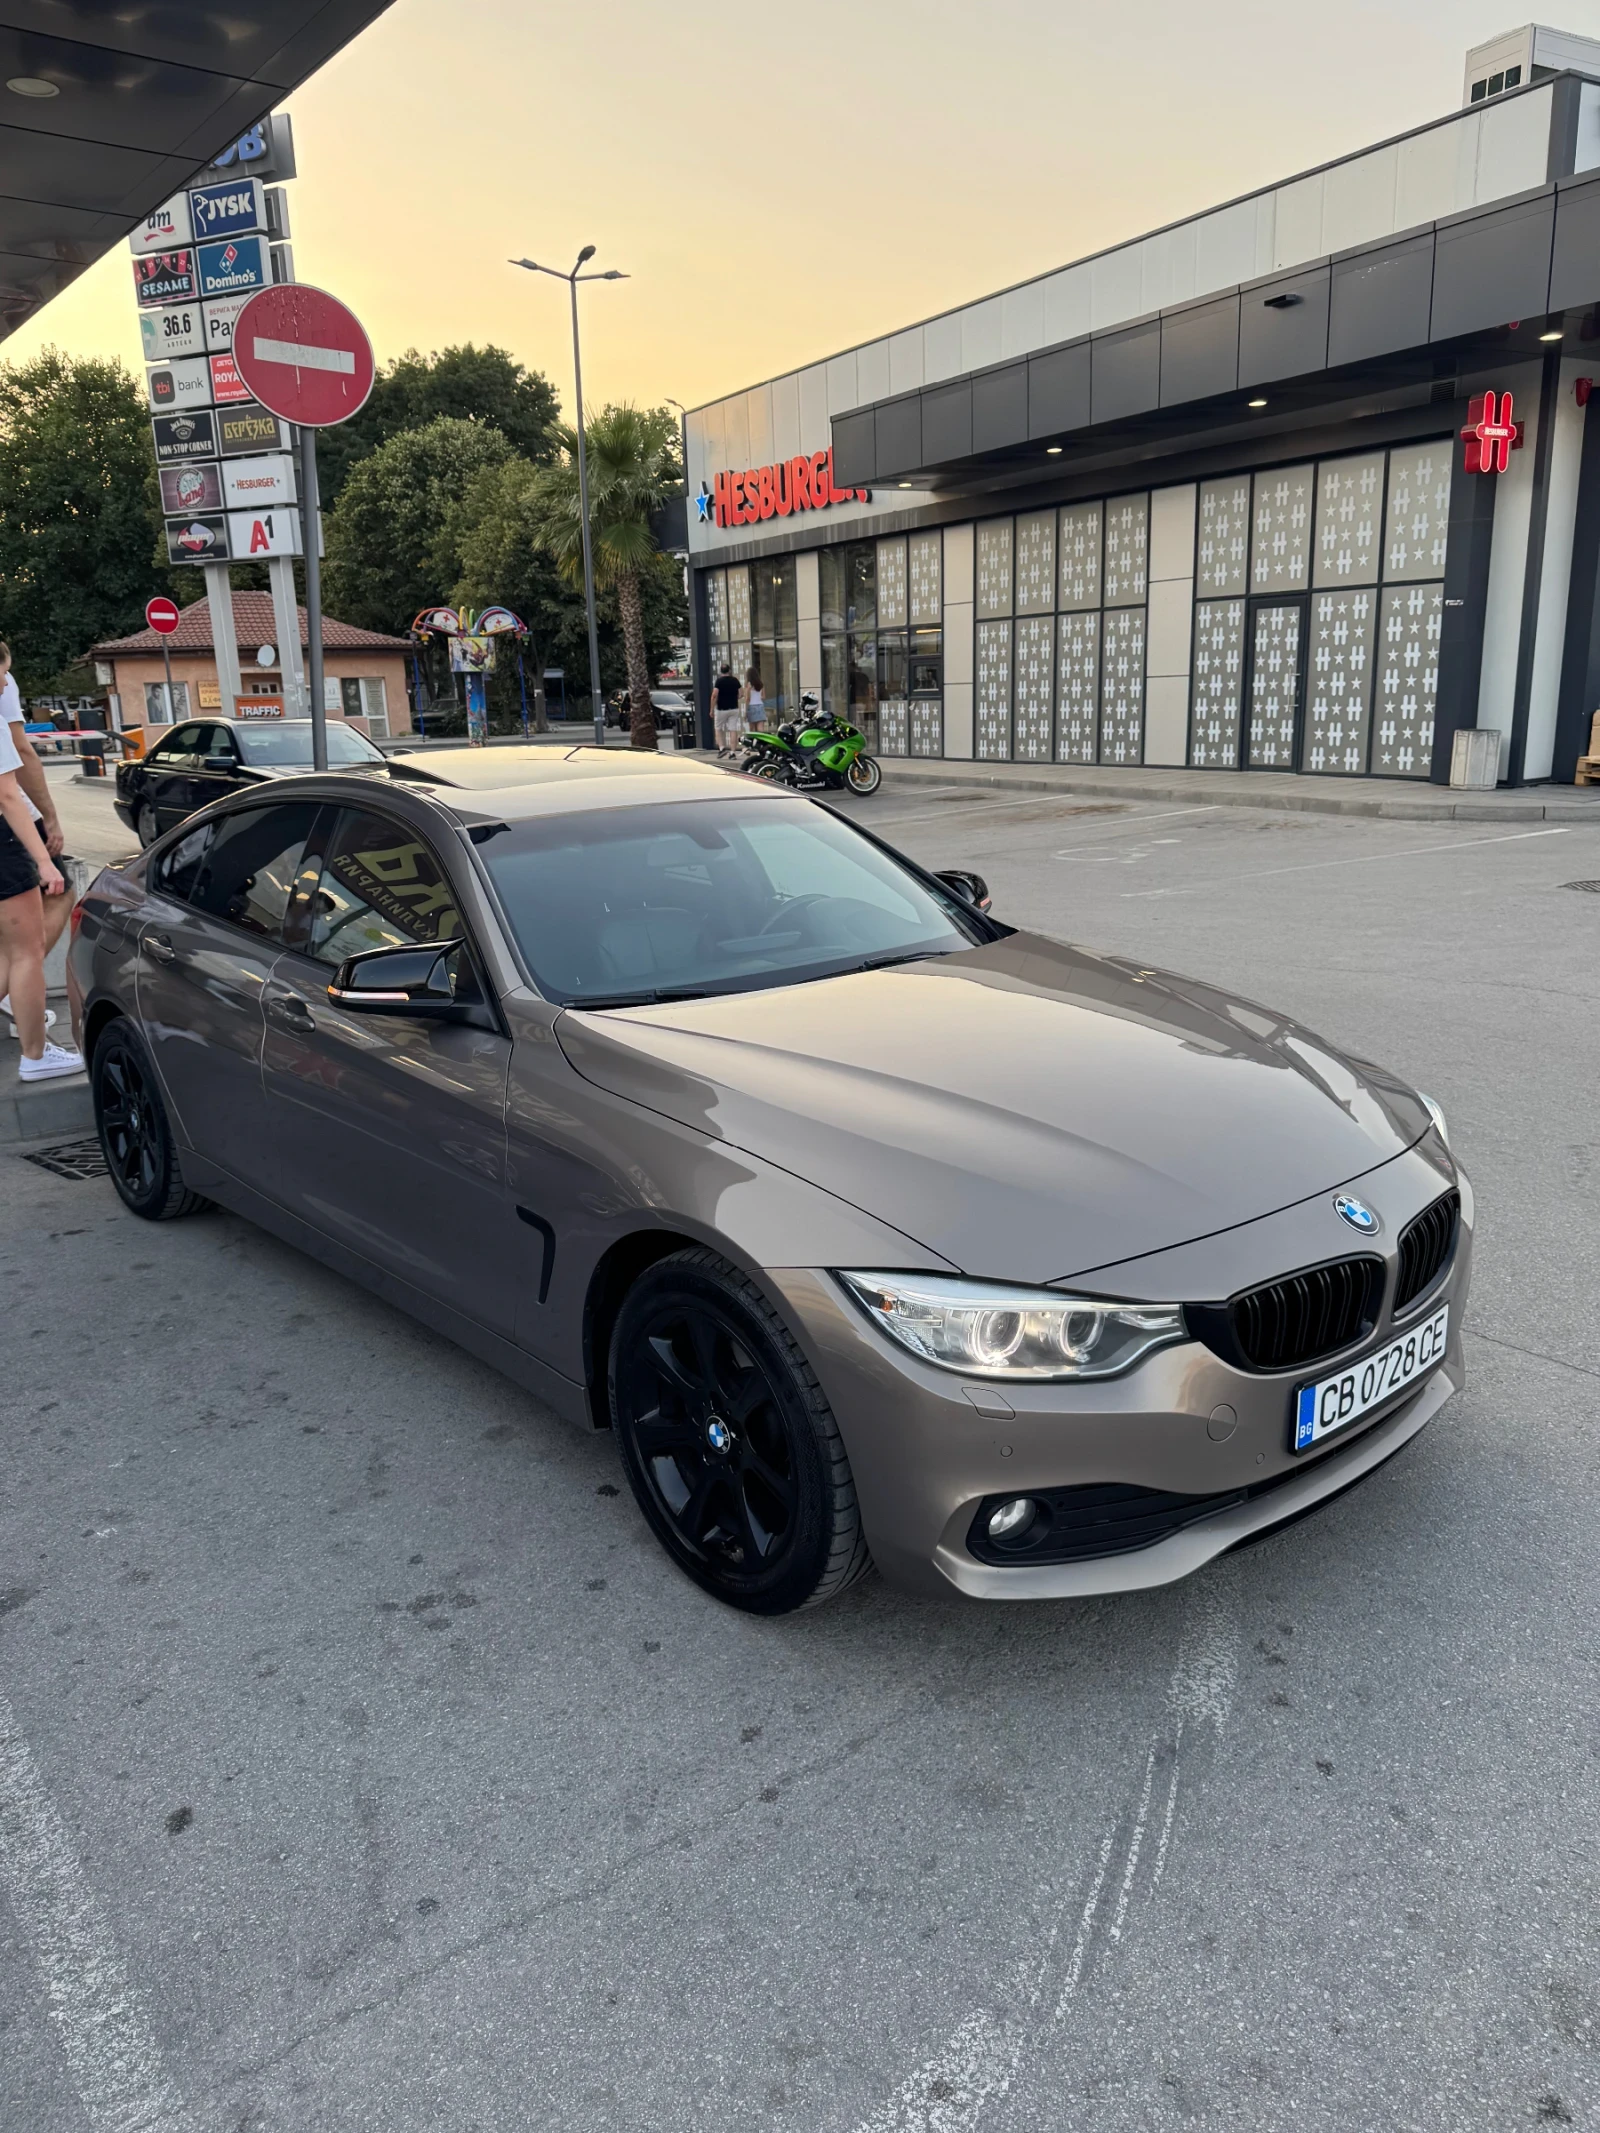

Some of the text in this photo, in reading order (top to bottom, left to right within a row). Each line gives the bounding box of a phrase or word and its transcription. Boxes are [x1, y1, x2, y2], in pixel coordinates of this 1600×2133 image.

[207, 192, 253, 220] JYSK
[142, 277, 189, 296] SESAME
[206, 269, 256, 290] Domino's
[163, 313, 191, 337] 36.6
[210, 319, 234, 338] Pa
[156, 377, 204, 394] tbi bank
[159, 440, 213, 455] NON-STOP CORNER
[236, 477, 276, 490] HESBURGER
[250, 515, 274, 553] A1
[239, 706, 281, 717] TRAFFIC
[796, 781, 826, 789] Kawasaki
[1319, 1314, 1445, 1428] CB 0728 CE
[1299, 1422, 1313, 1439] BG
